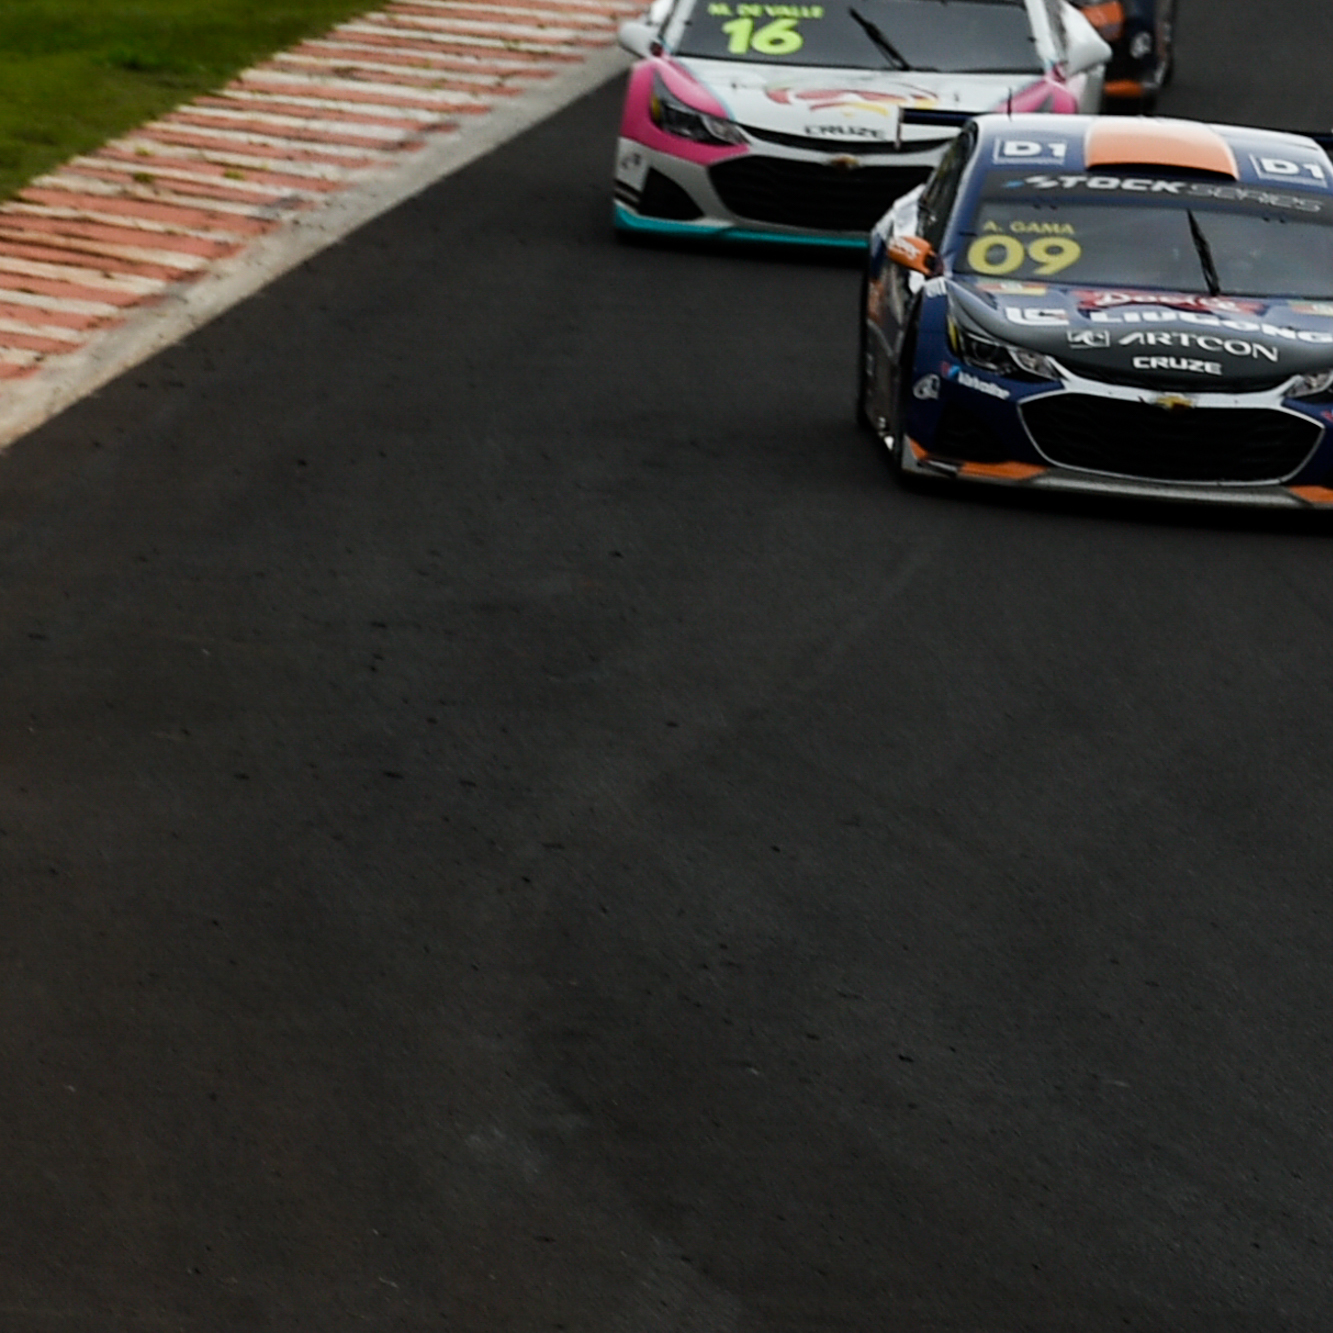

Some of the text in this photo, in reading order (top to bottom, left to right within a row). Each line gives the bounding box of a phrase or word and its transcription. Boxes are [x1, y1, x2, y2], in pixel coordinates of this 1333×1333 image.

[722, 17, 803, 55] 16
[1022, 174, 1182, 194] STOCK
[1009, 220, 1076, 235] GAMA
[967, 234, 1081, 275] 09
[1118, 330, 1279, 362] ARTCON
[1132, 355, 1223, 376] CRUZE
